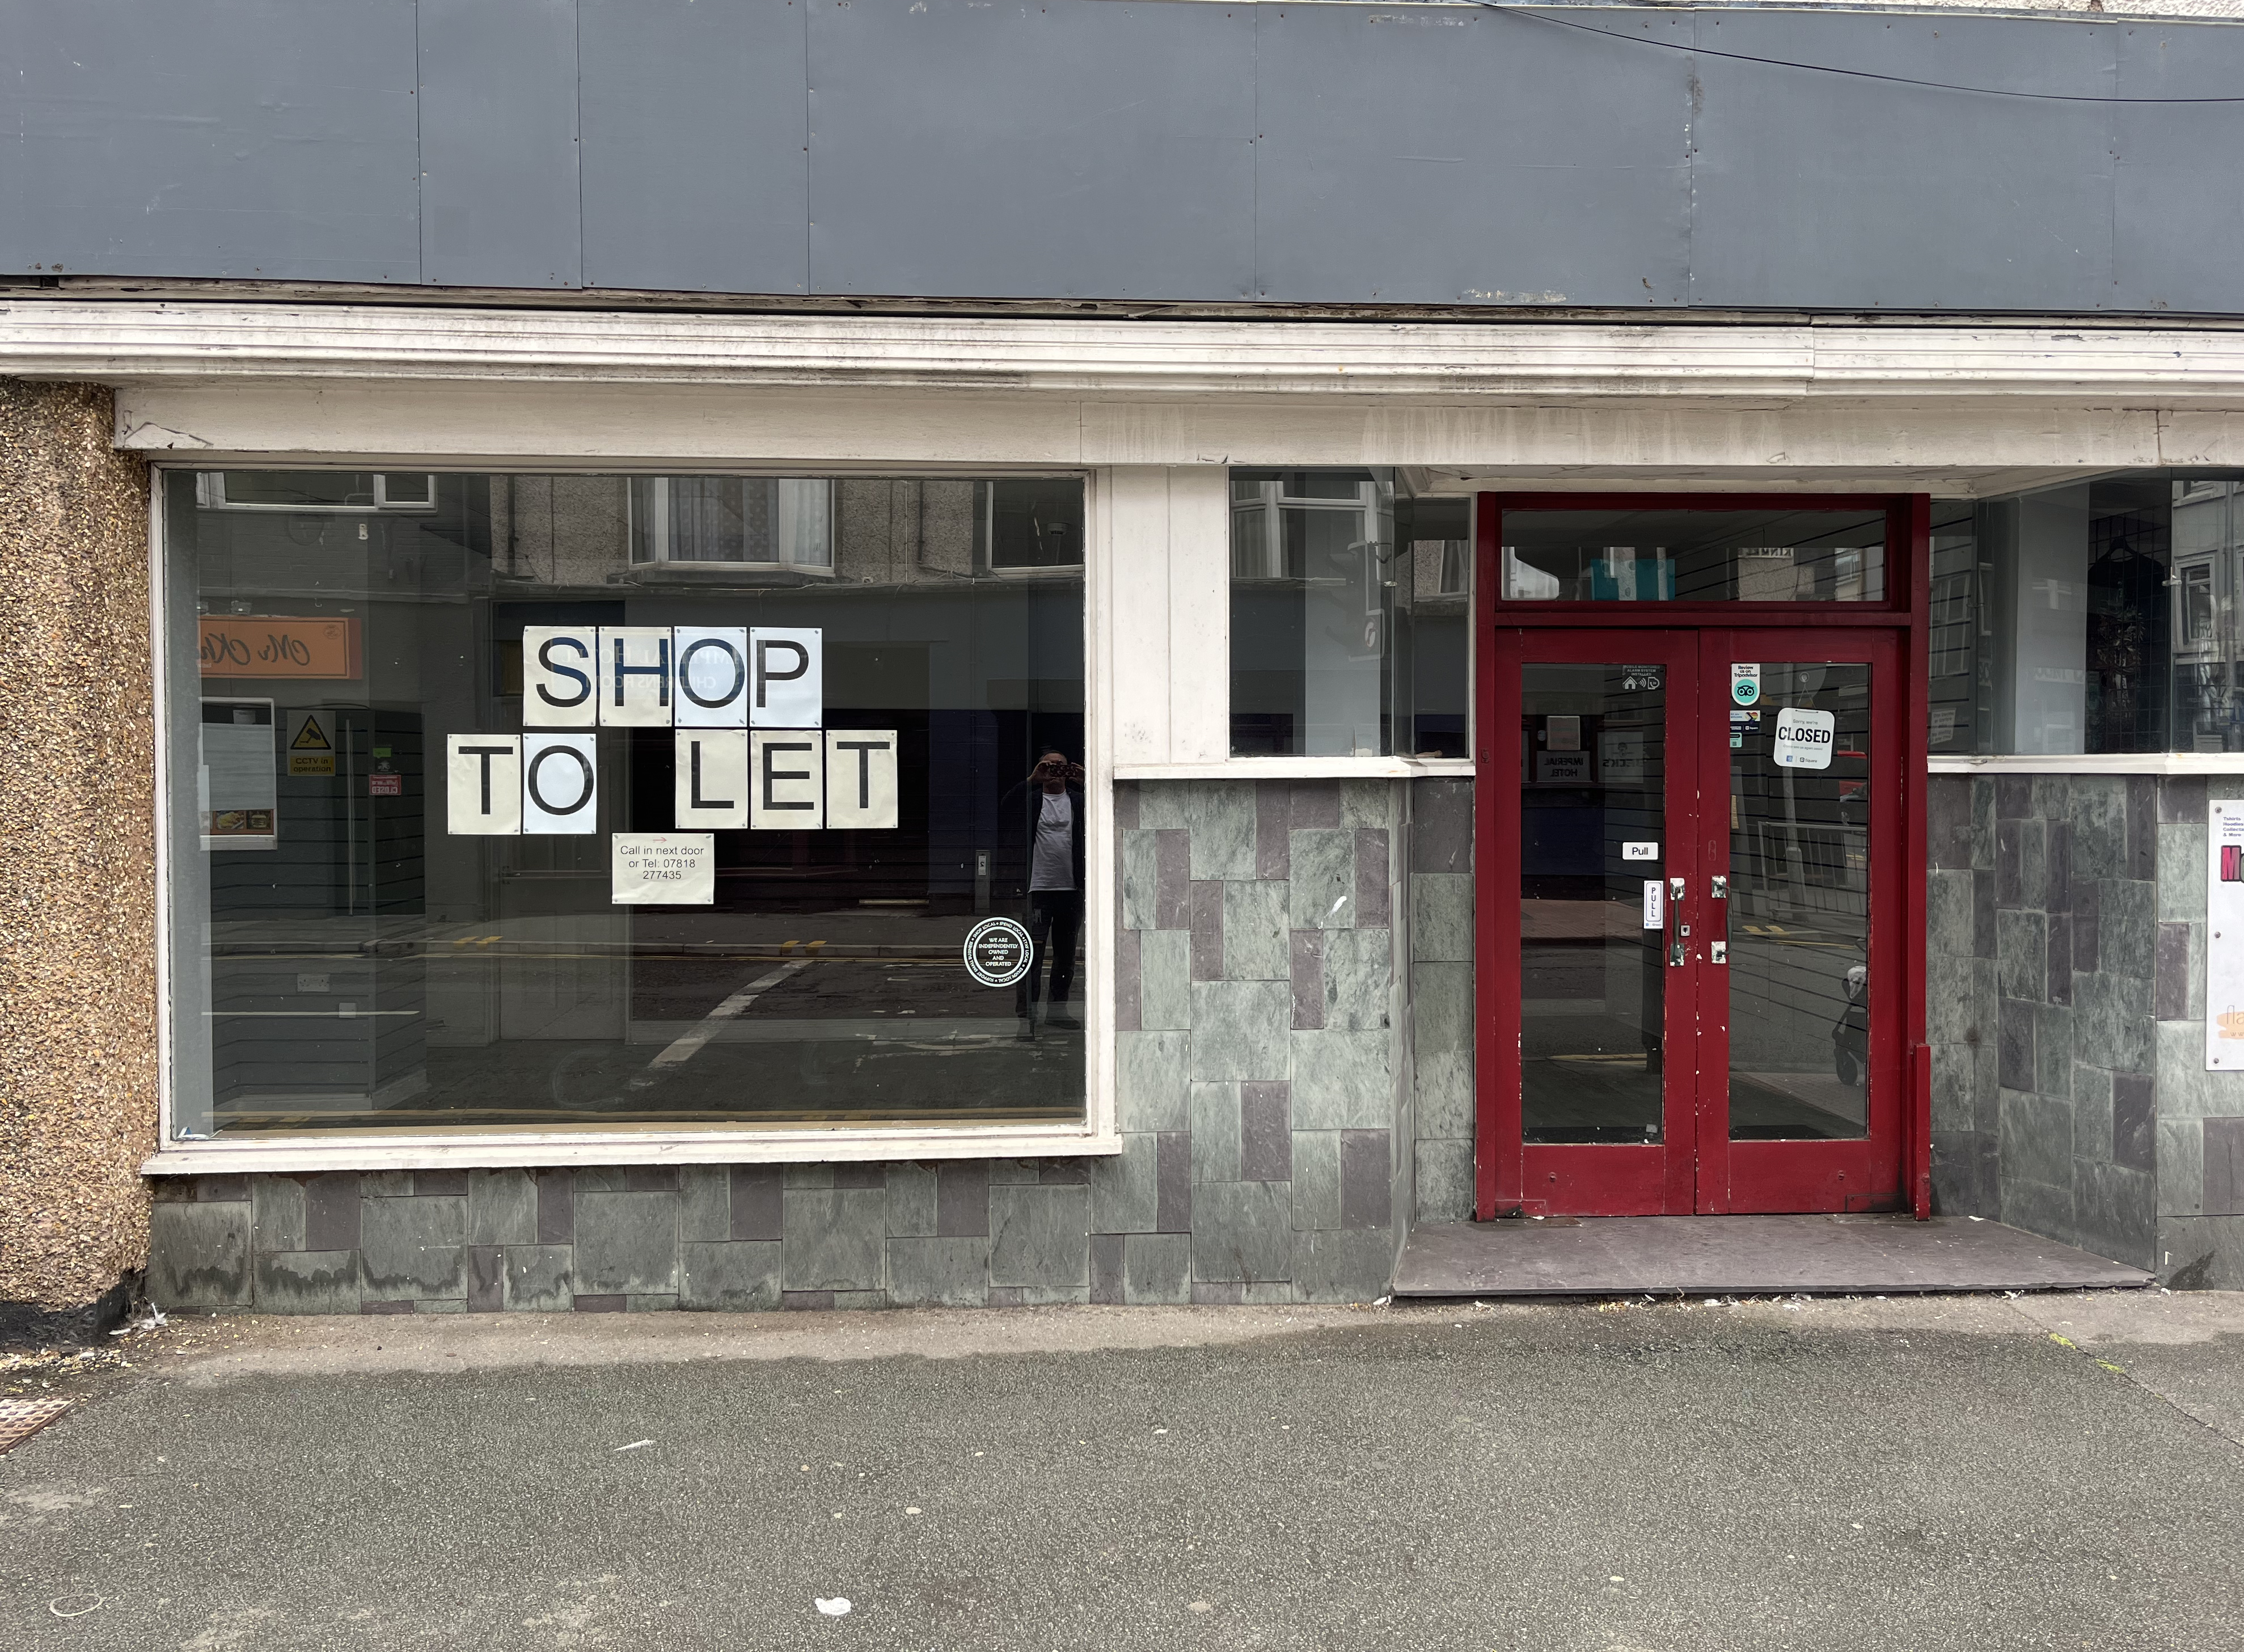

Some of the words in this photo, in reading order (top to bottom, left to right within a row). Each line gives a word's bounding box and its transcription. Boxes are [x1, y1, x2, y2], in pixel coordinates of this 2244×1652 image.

[536, 636, 809, 708] SHOP
[1778, 726, 1831, 743] CLOSED
[457, 745, 594, 816] TO
[690, 741, 890, 811] LET
[620, 846, 640, 855] Call
[644, 846, 652, 855] in
[656, 846, 678, 855] next
[681, 846, 704, 855] door
[1632, 847, 1649, 855] Pull
[642, 859, 660, 868] Tel:
[664, 859, 695, 868] 07818
[643, 871, 682, 880] 277435
[973, 928, 982, 938] SHOP
[982, 922, 996, 930] LOCAL
[1012, 926, 1023, 937] LOCAL
